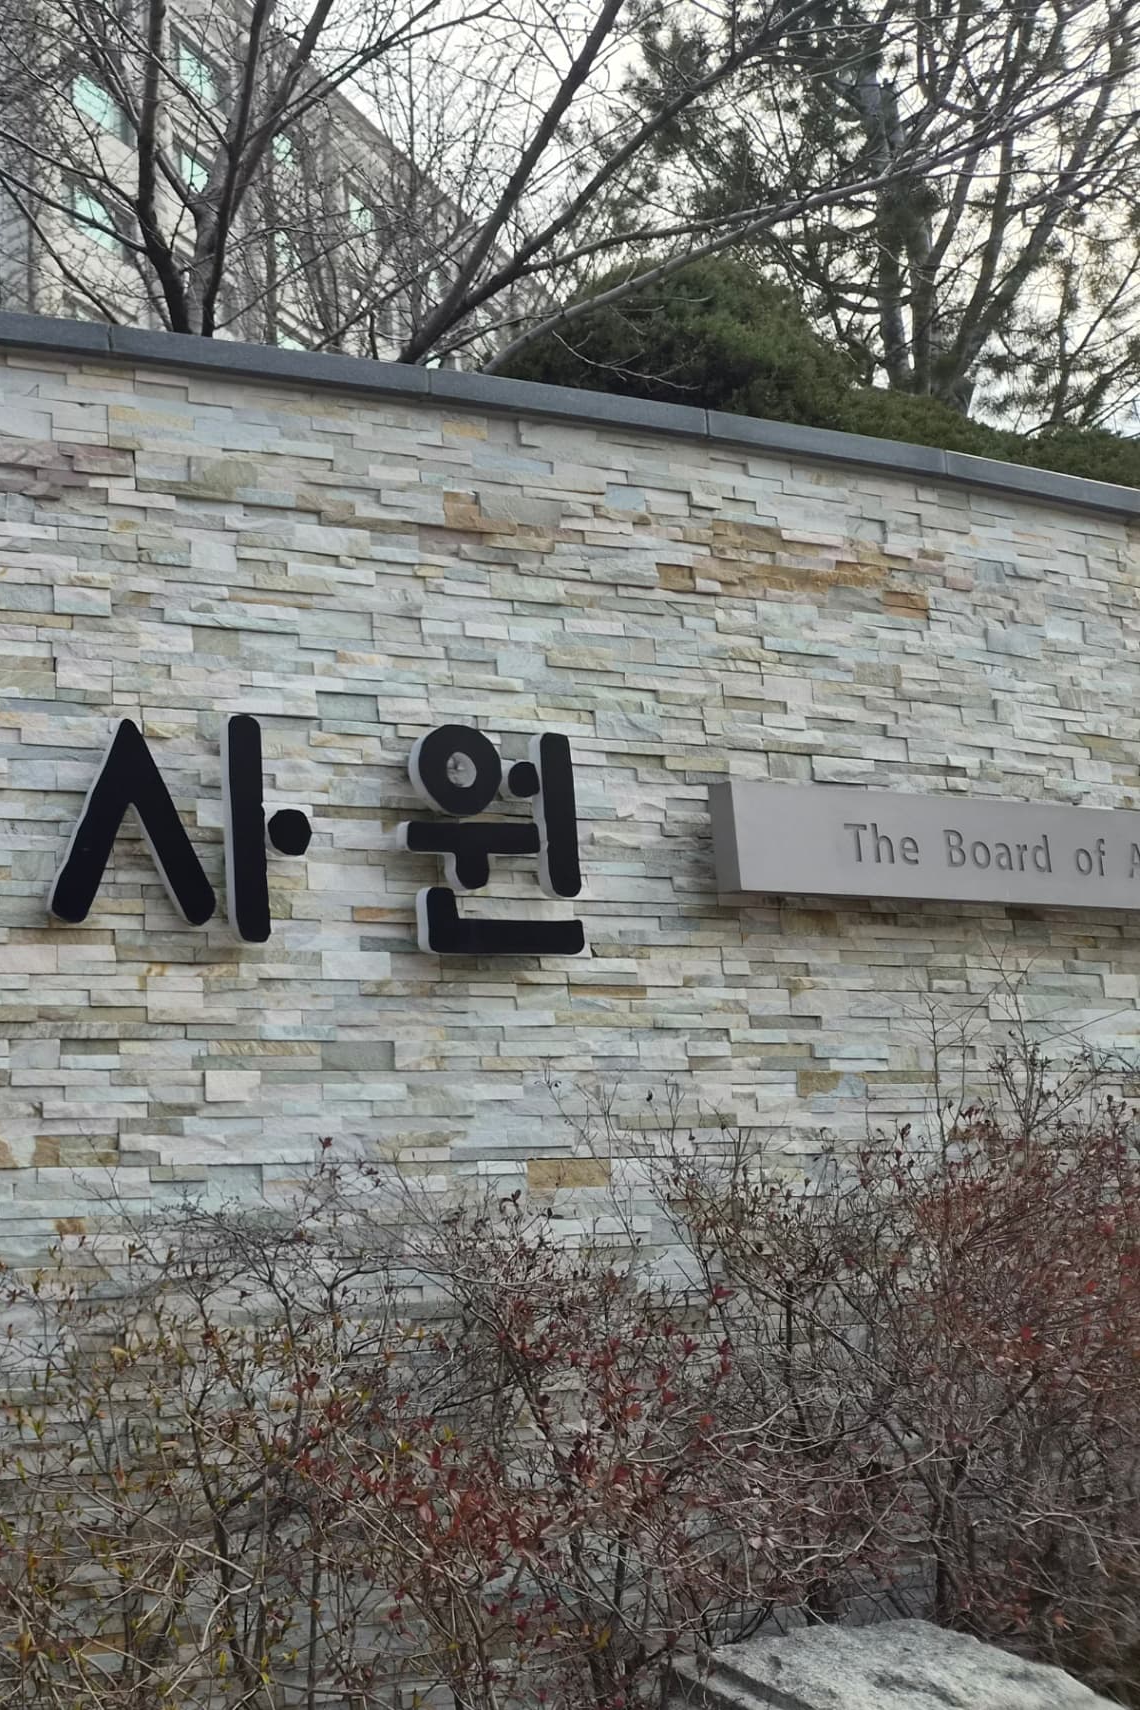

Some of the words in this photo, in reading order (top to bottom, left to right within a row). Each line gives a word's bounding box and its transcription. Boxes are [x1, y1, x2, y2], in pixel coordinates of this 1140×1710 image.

[844, 823, 919, 865] The
[943, 829, 1052, 873] Board
[1074, 838, 1105, 876] of
